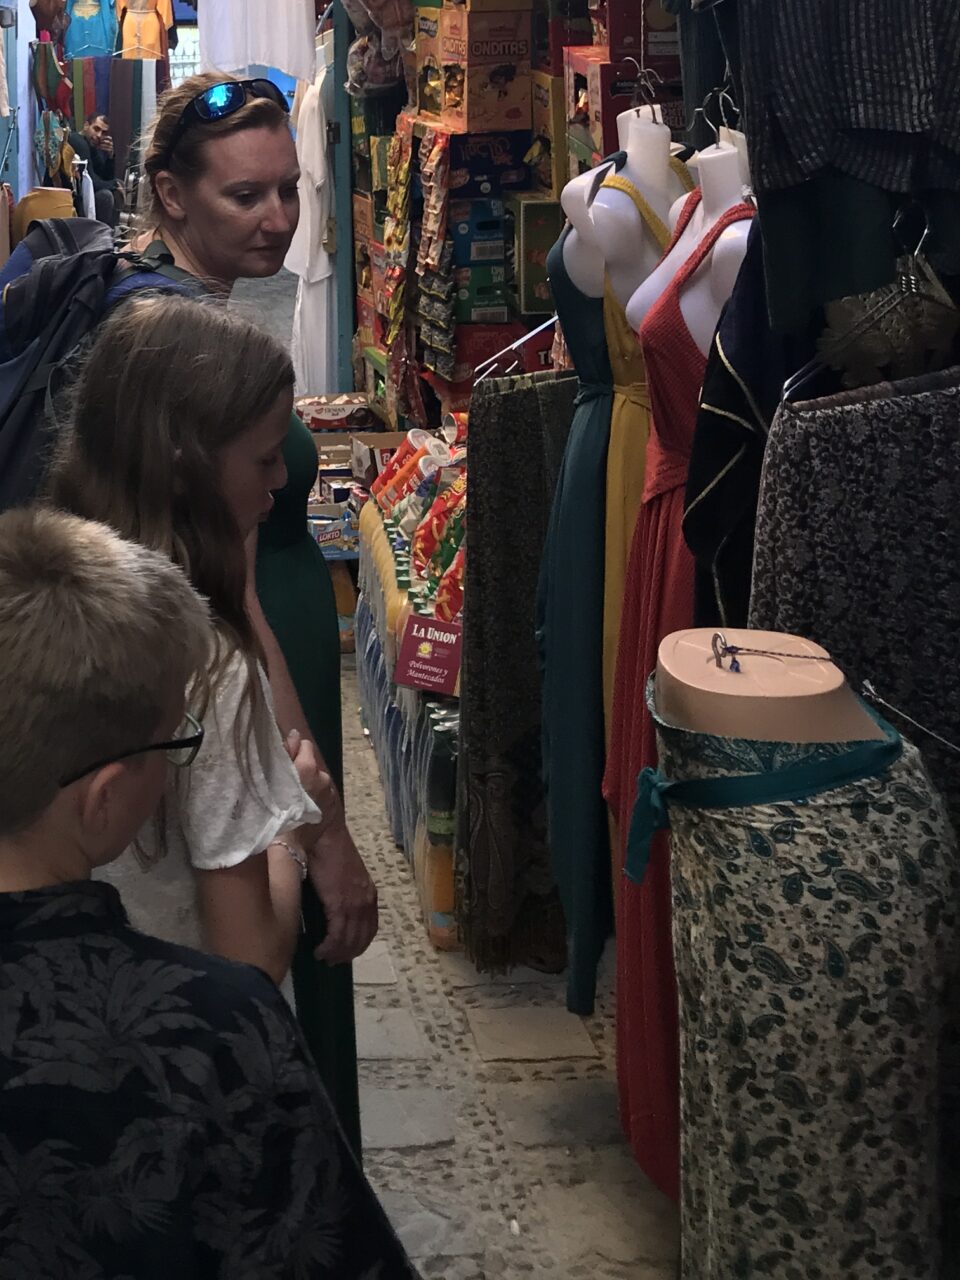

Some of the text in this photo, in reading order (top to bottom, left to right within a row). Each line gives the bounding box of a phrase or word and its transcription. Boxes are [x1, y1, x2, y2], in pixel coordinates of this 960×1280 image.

[471, 40, 529, 58] ONDITAS
[412, 624, 457, 645] LA UNION
